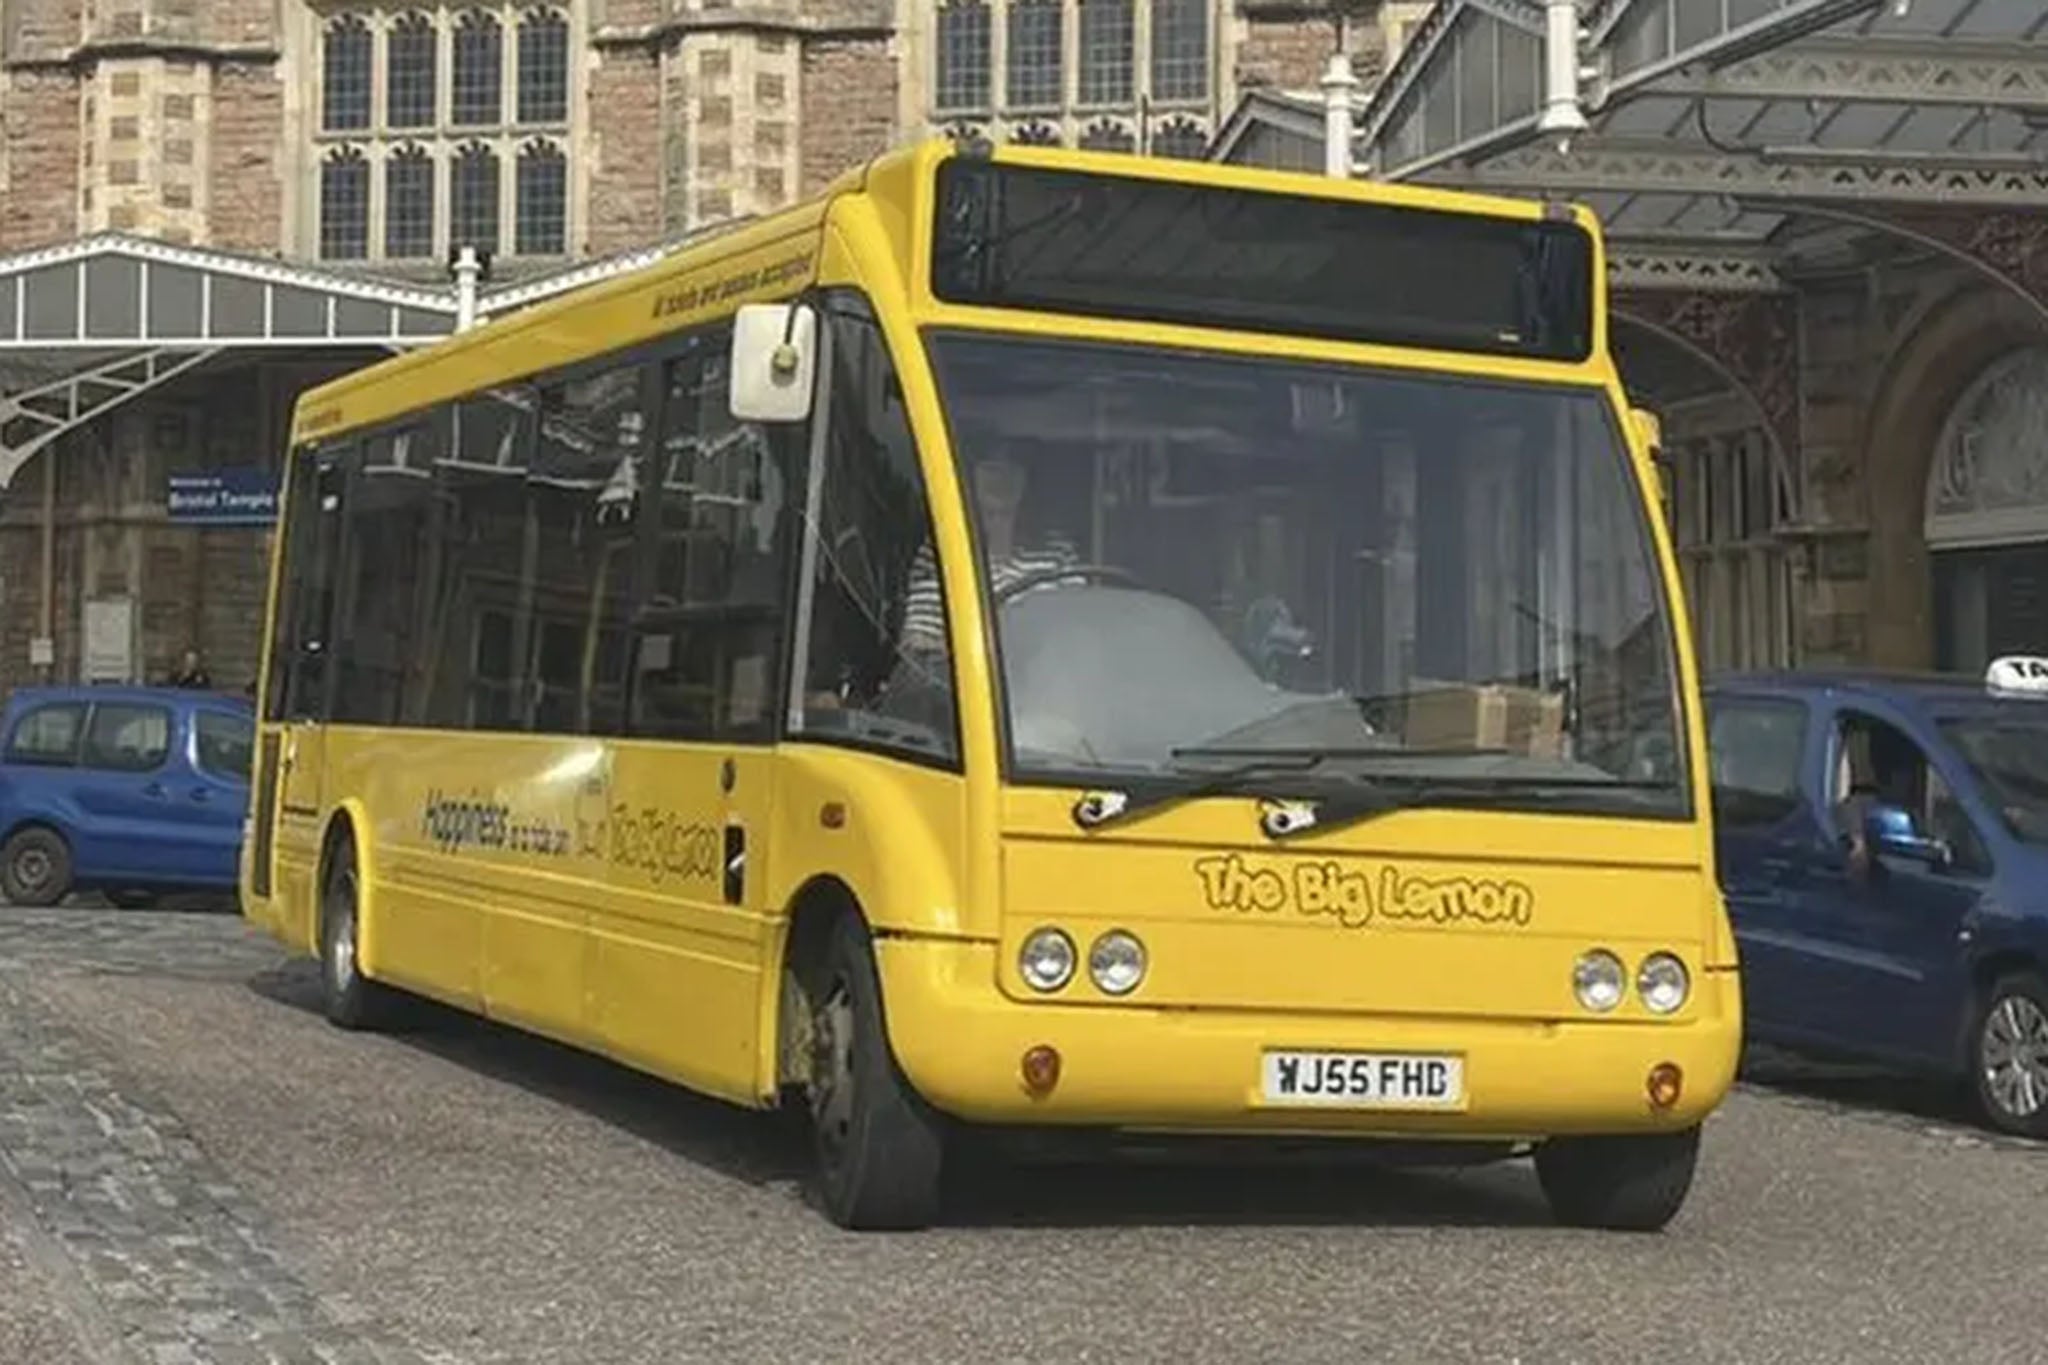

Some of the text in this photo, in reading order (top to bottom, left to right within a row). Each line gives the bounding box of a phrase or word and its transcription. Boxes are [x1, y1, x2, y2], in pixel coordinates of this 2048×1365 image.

[169, 491, 274, 510] Bristol Temple
[420, 788, 509, 855] Happiness
[1195, 854, 1533, 928] The Big Lemon
[1278, 1057, 1370, 1095] WJ55
